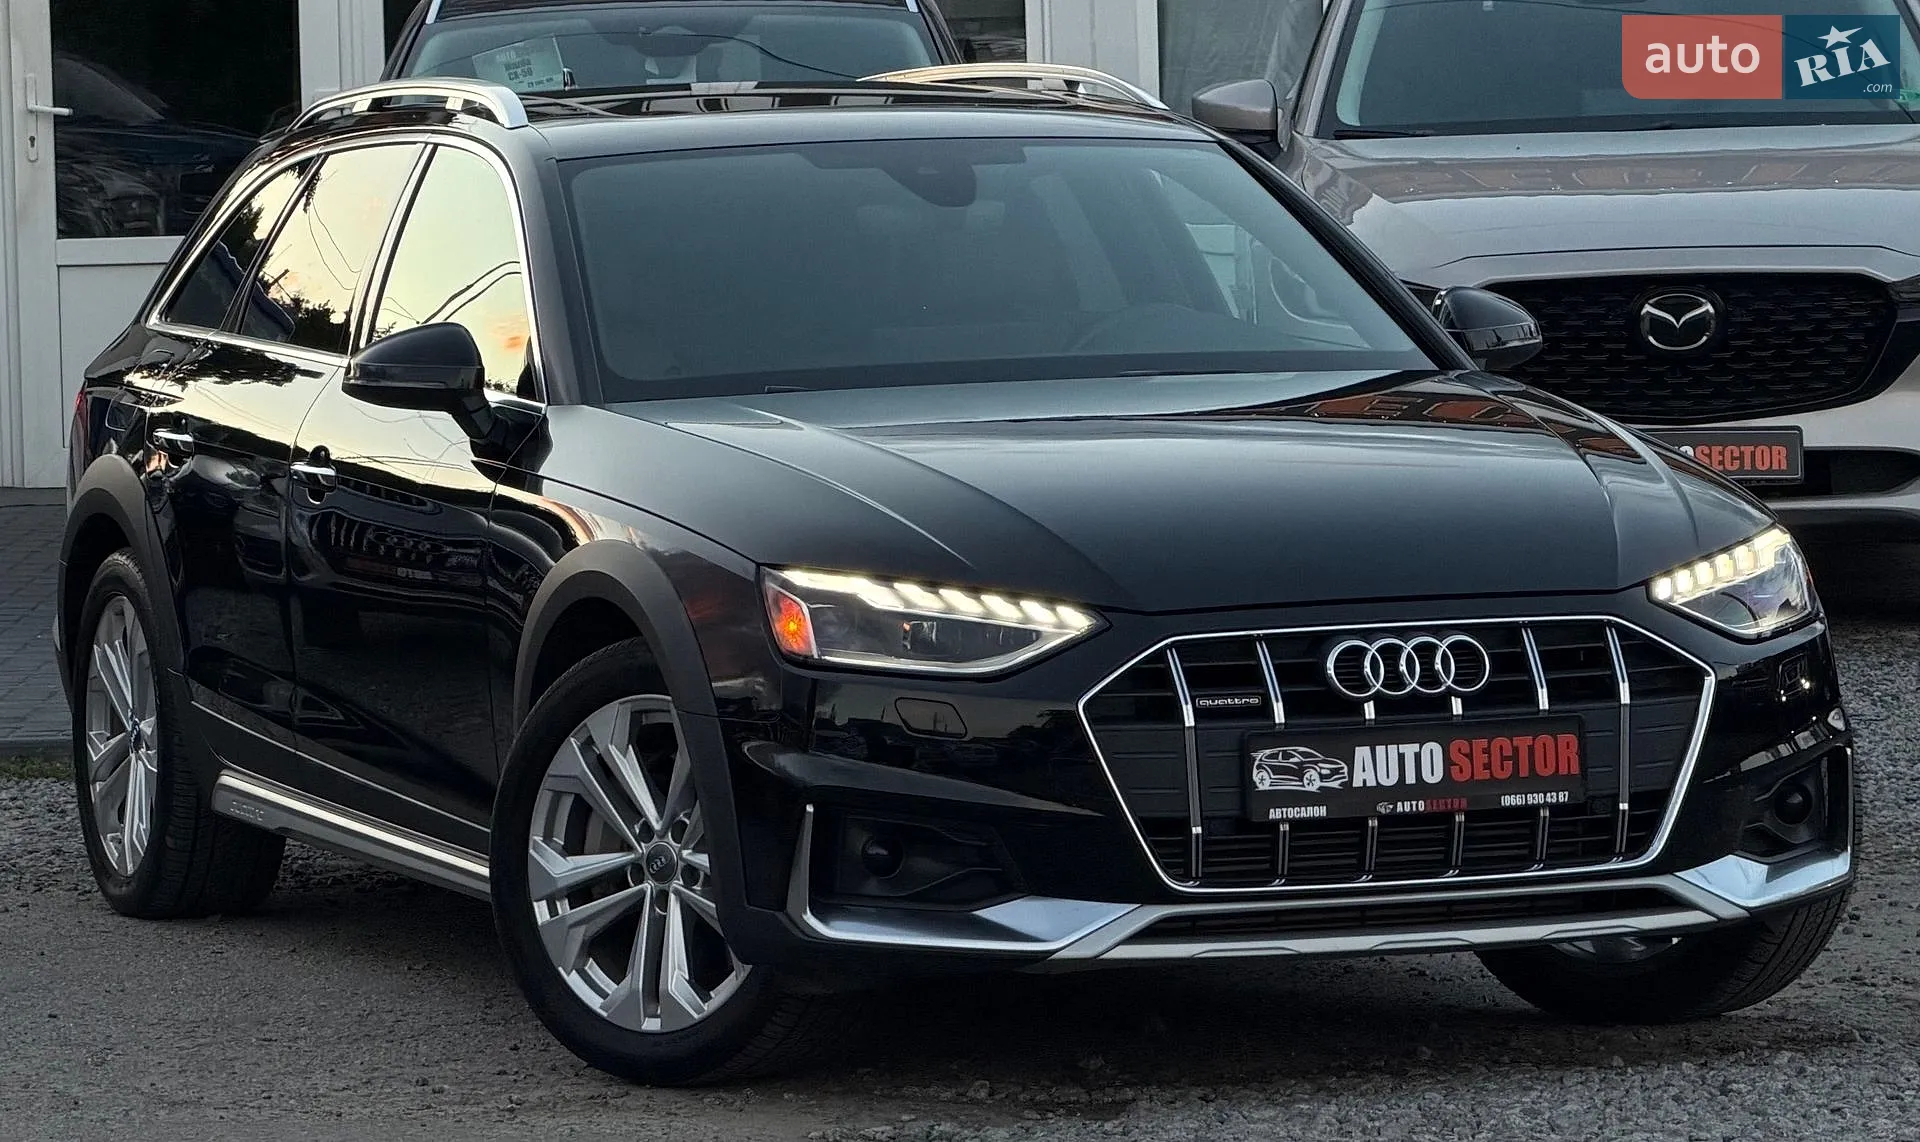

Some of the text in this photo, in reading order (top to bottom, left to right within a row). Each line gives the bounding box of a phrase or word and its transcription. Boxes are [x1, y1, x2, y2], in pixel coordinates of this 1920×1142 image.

[1694, 445, 1788, 471] SECTOR
[1200, 698, 1259, 707] quattro
[1352, 734, 1581, 788] AUTO SECTOR
[1269, 805, 1327, 819] АВТОСАЛОН
[1396, 800, 1425, 813] AUTO
